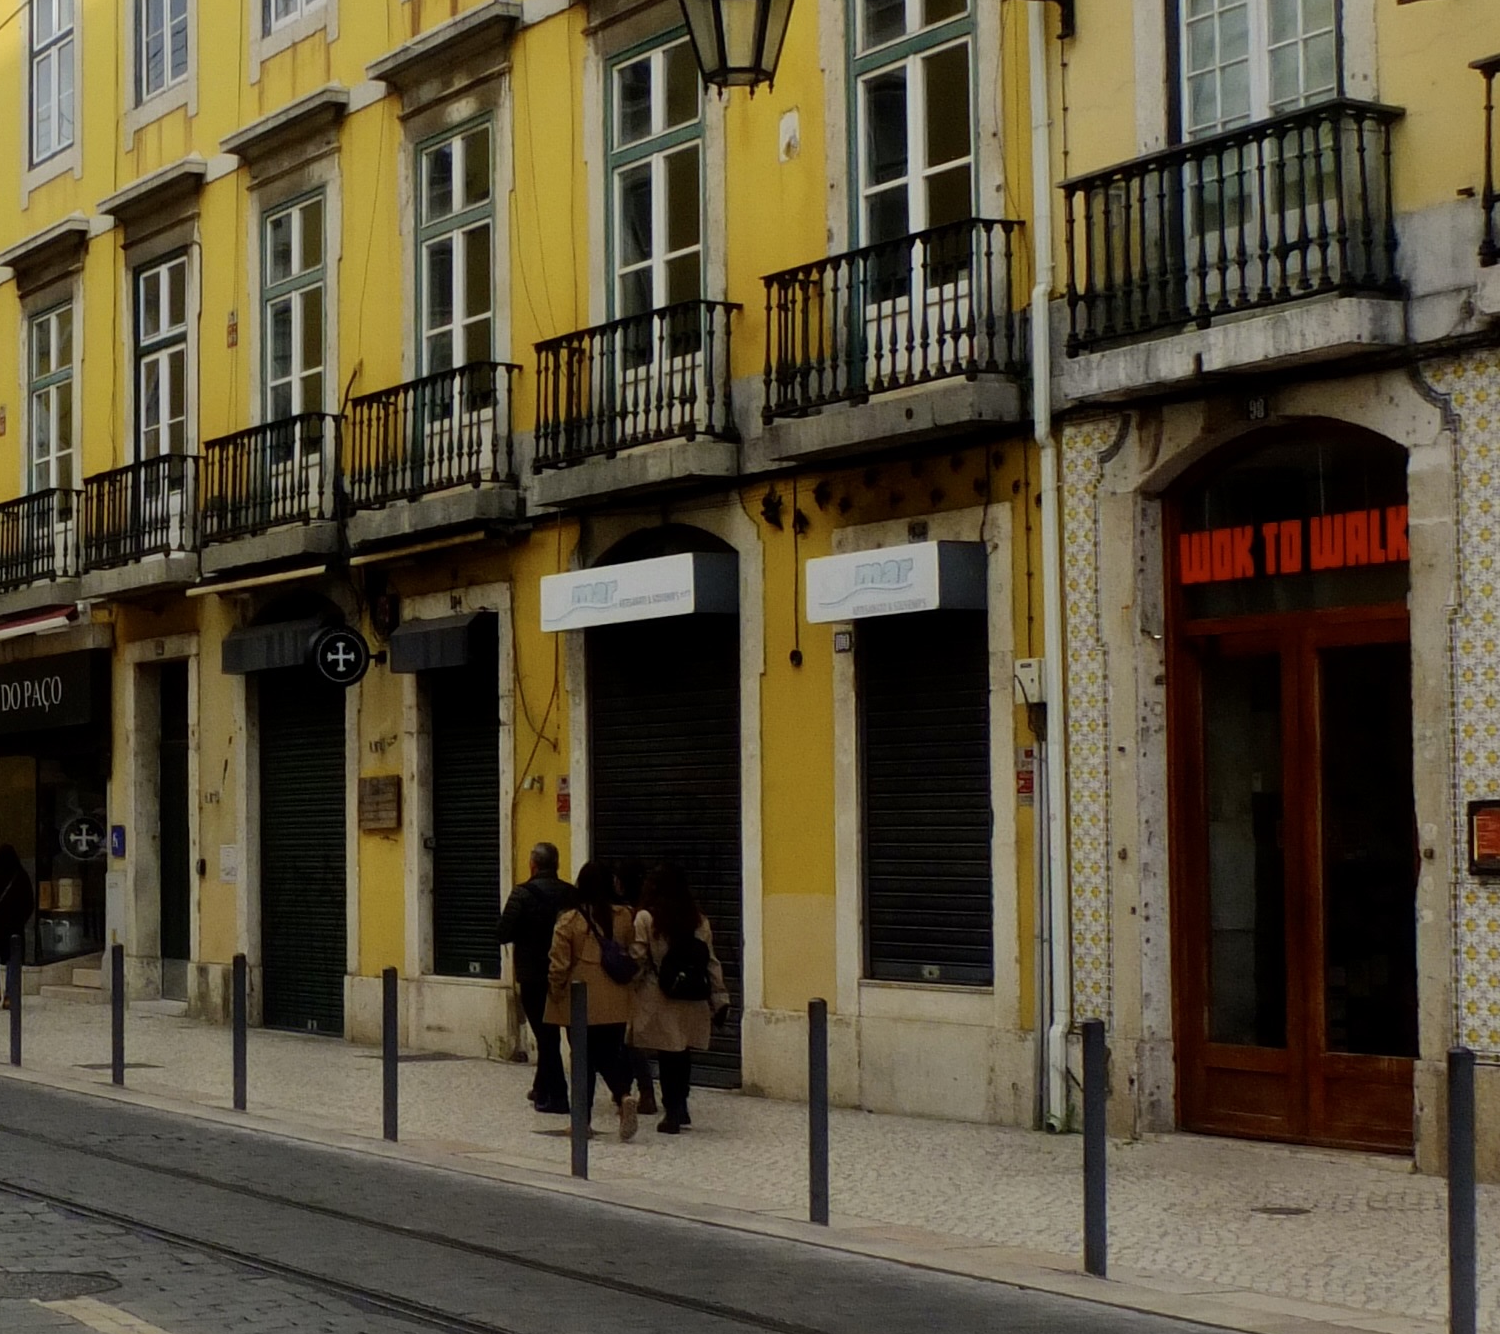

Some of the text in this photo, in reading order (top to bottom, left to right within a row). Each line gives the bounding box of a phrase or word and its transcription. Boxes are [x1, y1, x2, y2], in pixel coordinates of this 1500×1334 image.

[1179, 504, 1409, 585] WOK TO WALK
[854, 557, 914, 587] mar
[571, 579, 618, 604] mar
[1, 681, 21, 711] DO
[23, 675, 63, 713] PAÇO
